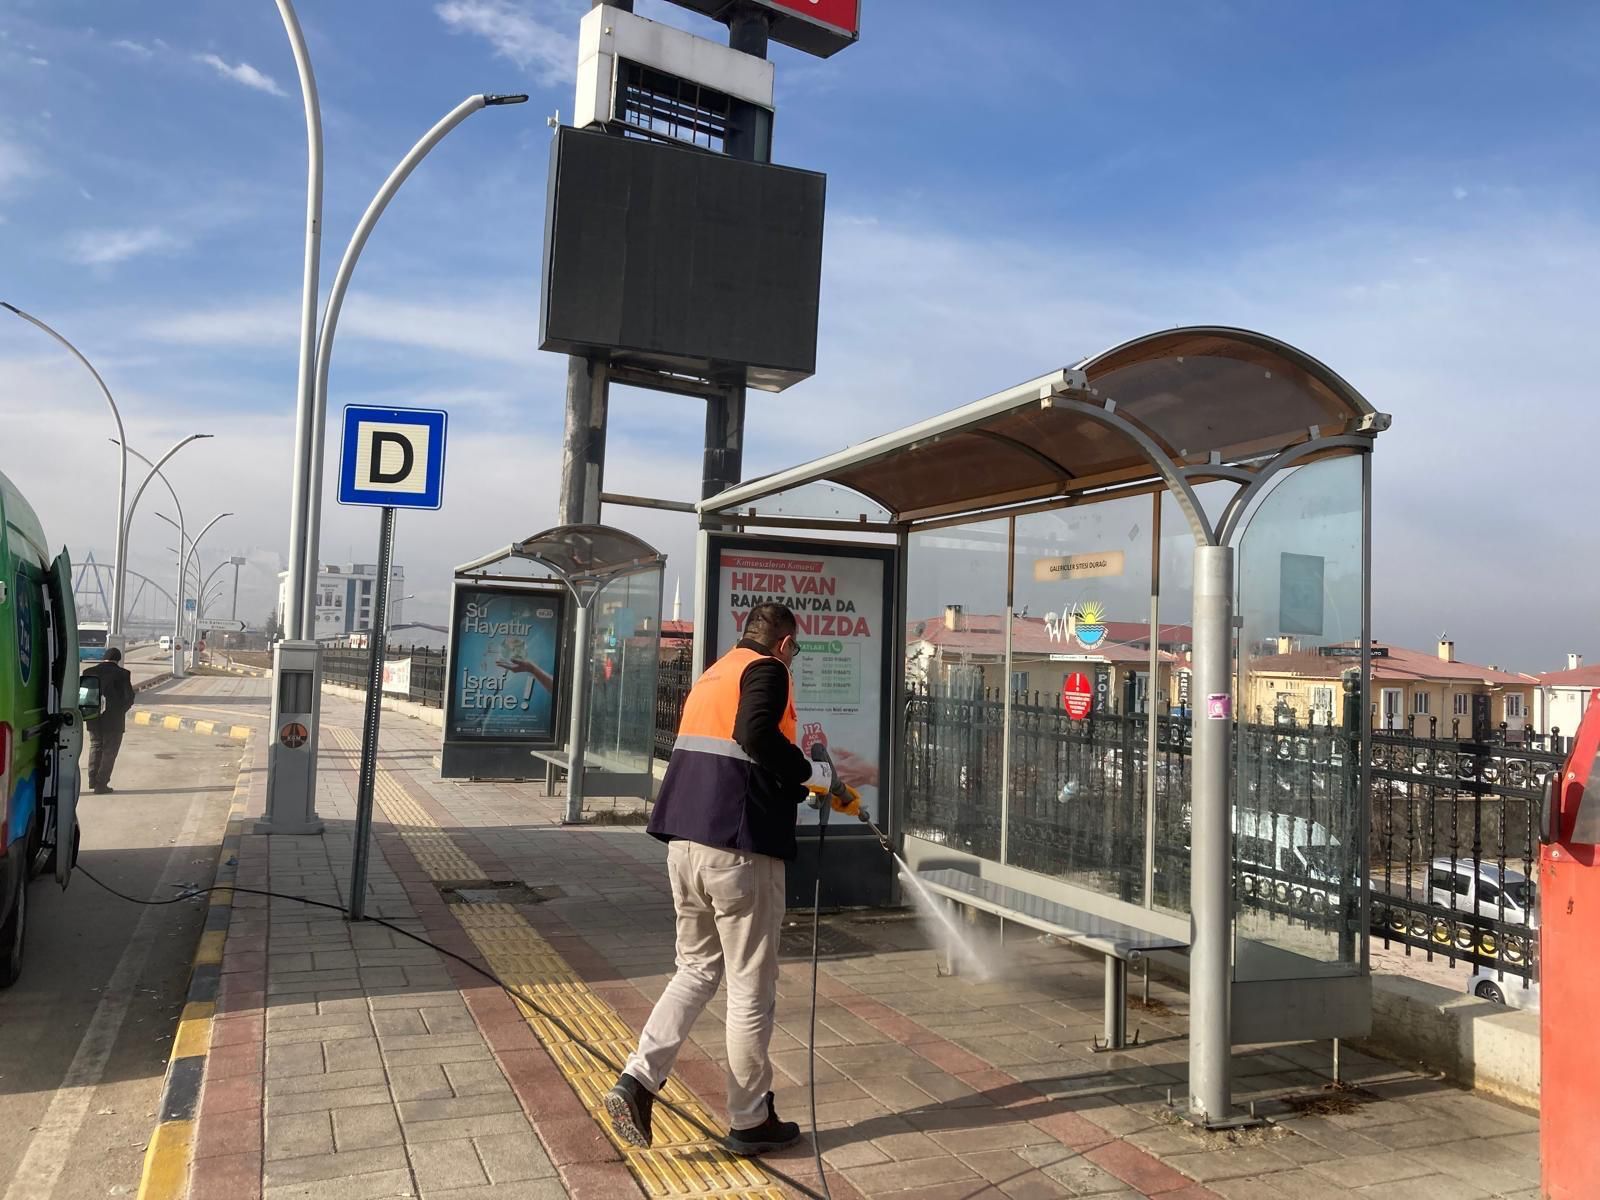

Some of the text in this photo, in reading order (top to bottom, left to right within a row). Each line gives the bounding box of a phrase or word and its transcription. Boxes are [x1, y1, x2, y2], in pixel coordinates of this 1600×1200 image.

[370, 431, 414, 483] D
[731, 571, 836, 596] HIZIR VAN
[465, 602, 488, 618] Su
[836, 600, 856, 613] DA
[464, 617, 532, 638] Hayattır
[731, 611, 870, 637] YNIZDA
[803, 723, 821, 735] 112
